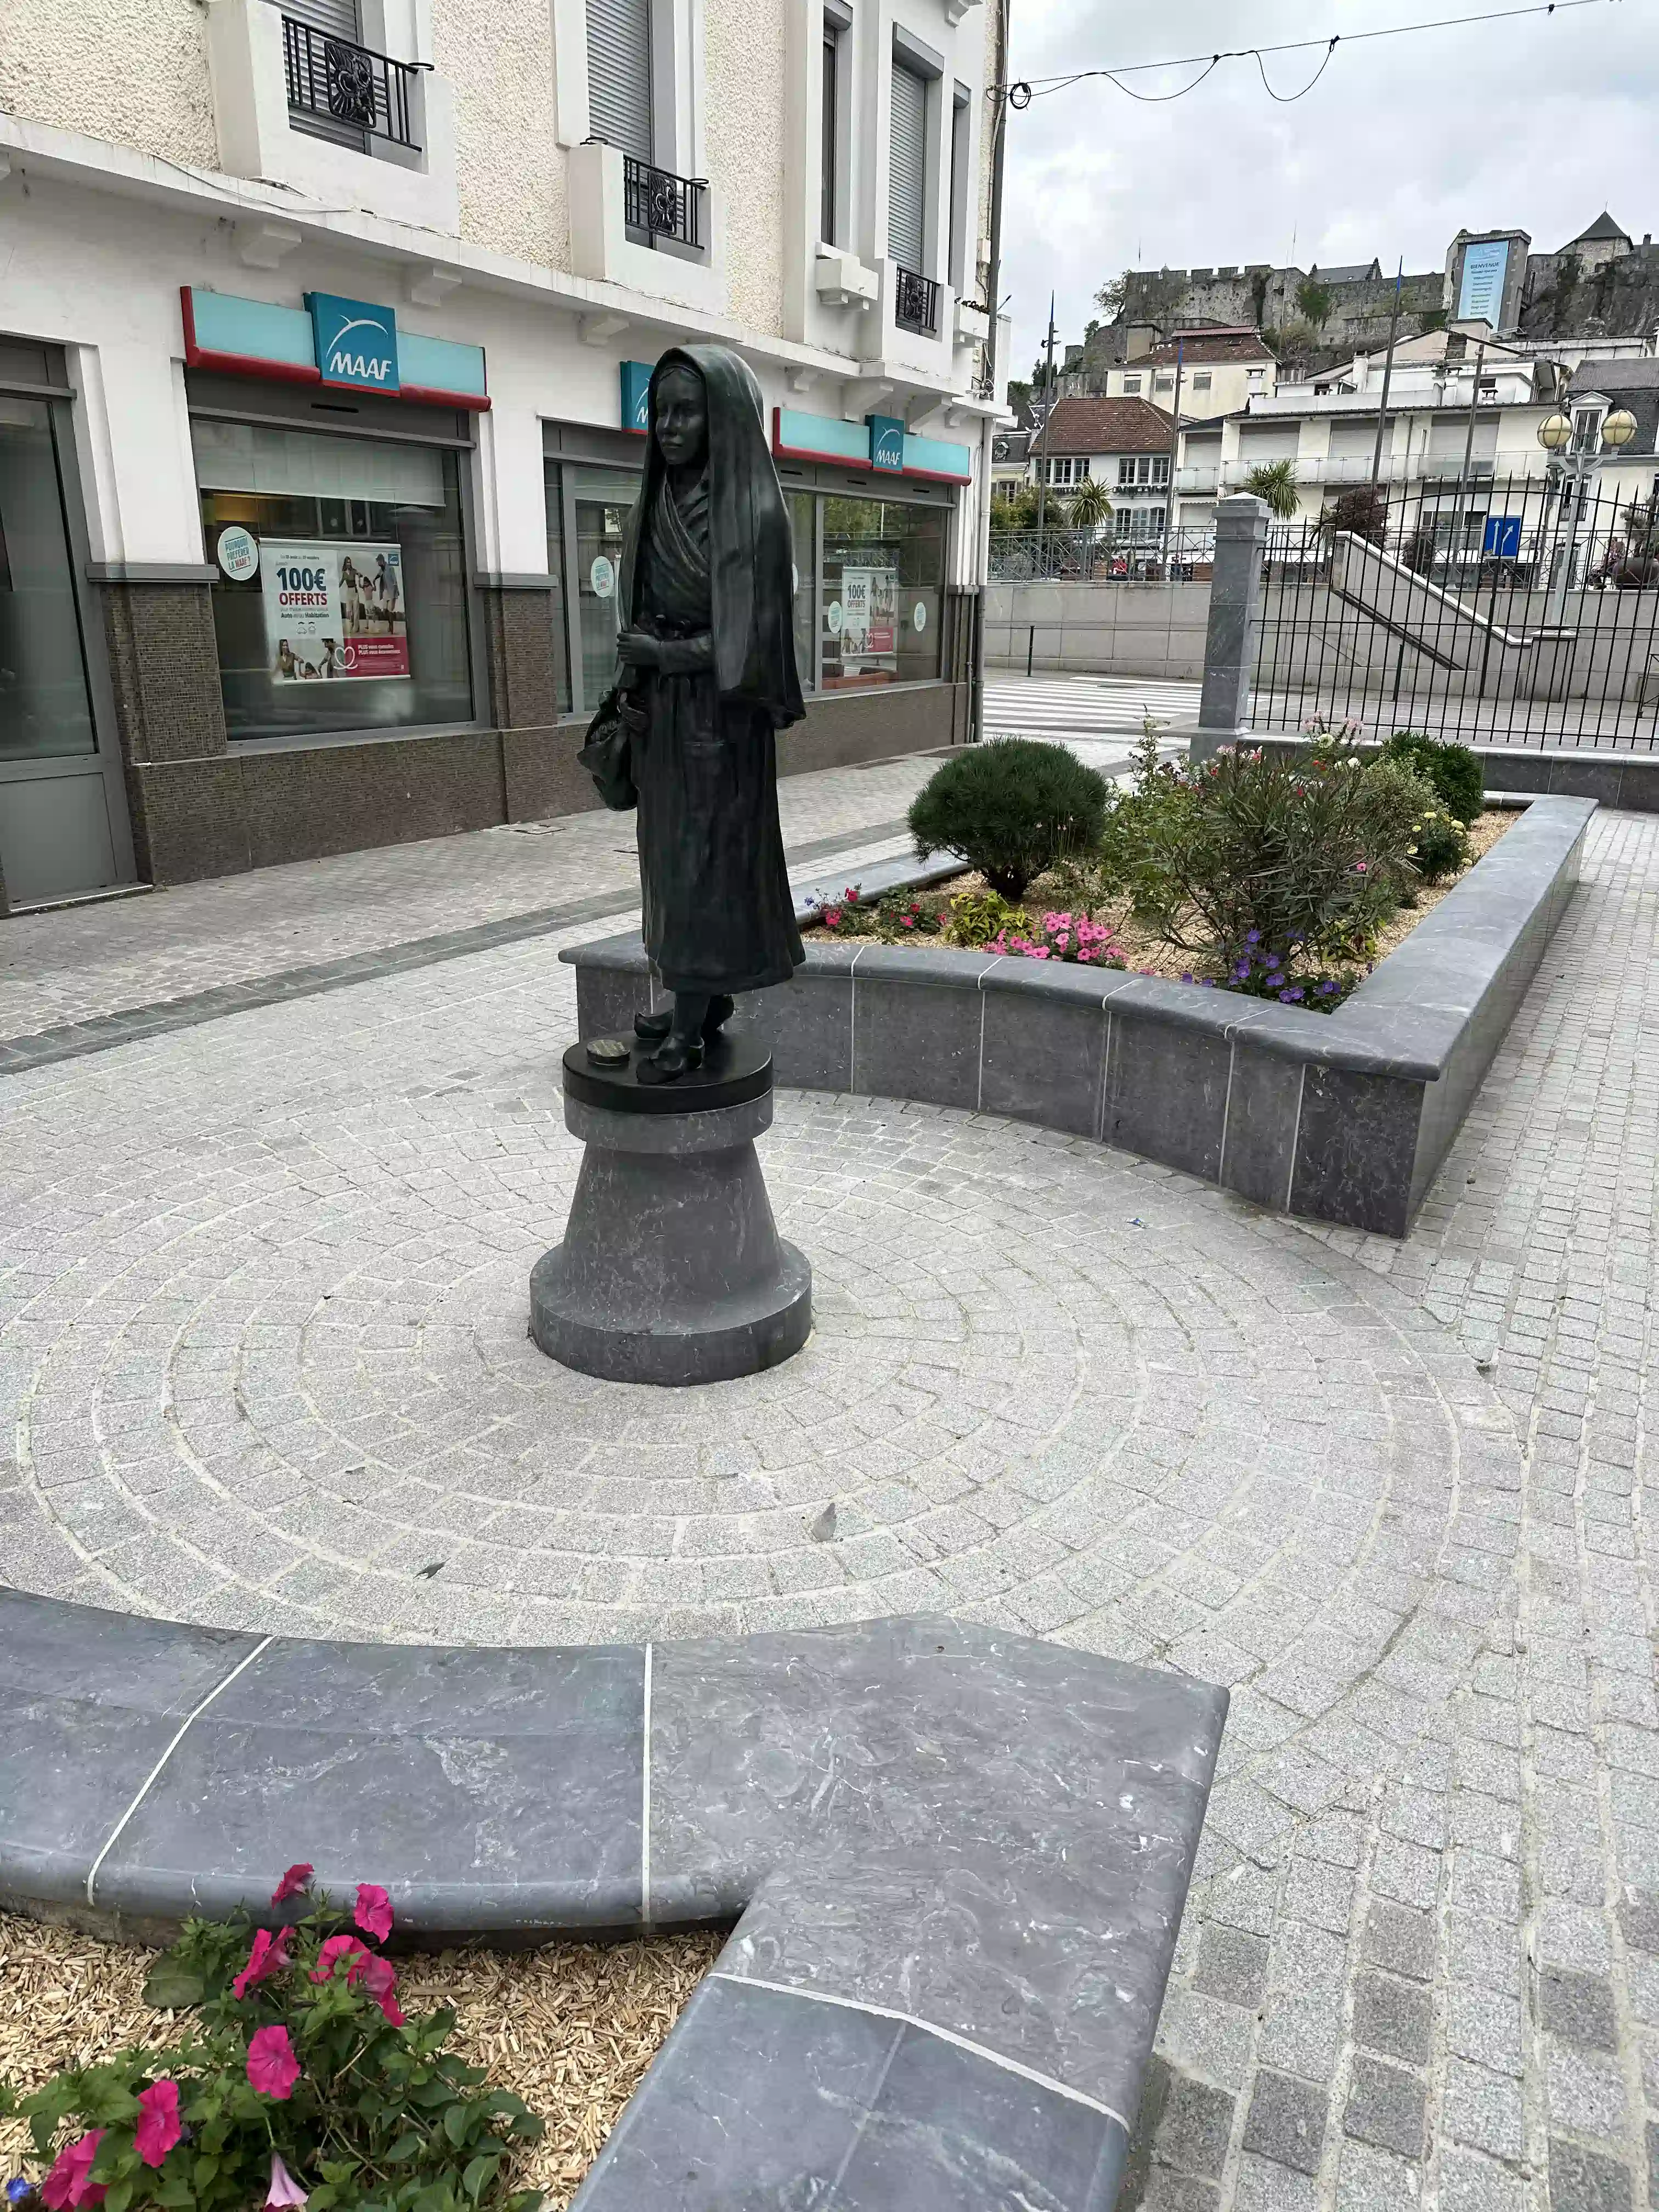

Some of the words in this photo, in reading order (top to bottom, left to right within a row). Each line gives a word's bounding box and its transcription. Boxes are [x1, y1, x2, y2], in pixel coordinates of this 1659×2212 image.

[329, 351, 392, 380] MAAF
[876, 449, 900, 465] MAAF
[276, 568, 326, 591] 100€
[279, 592, 328, 605] OFFERTS
[848, 584, 866, 599] 100€
